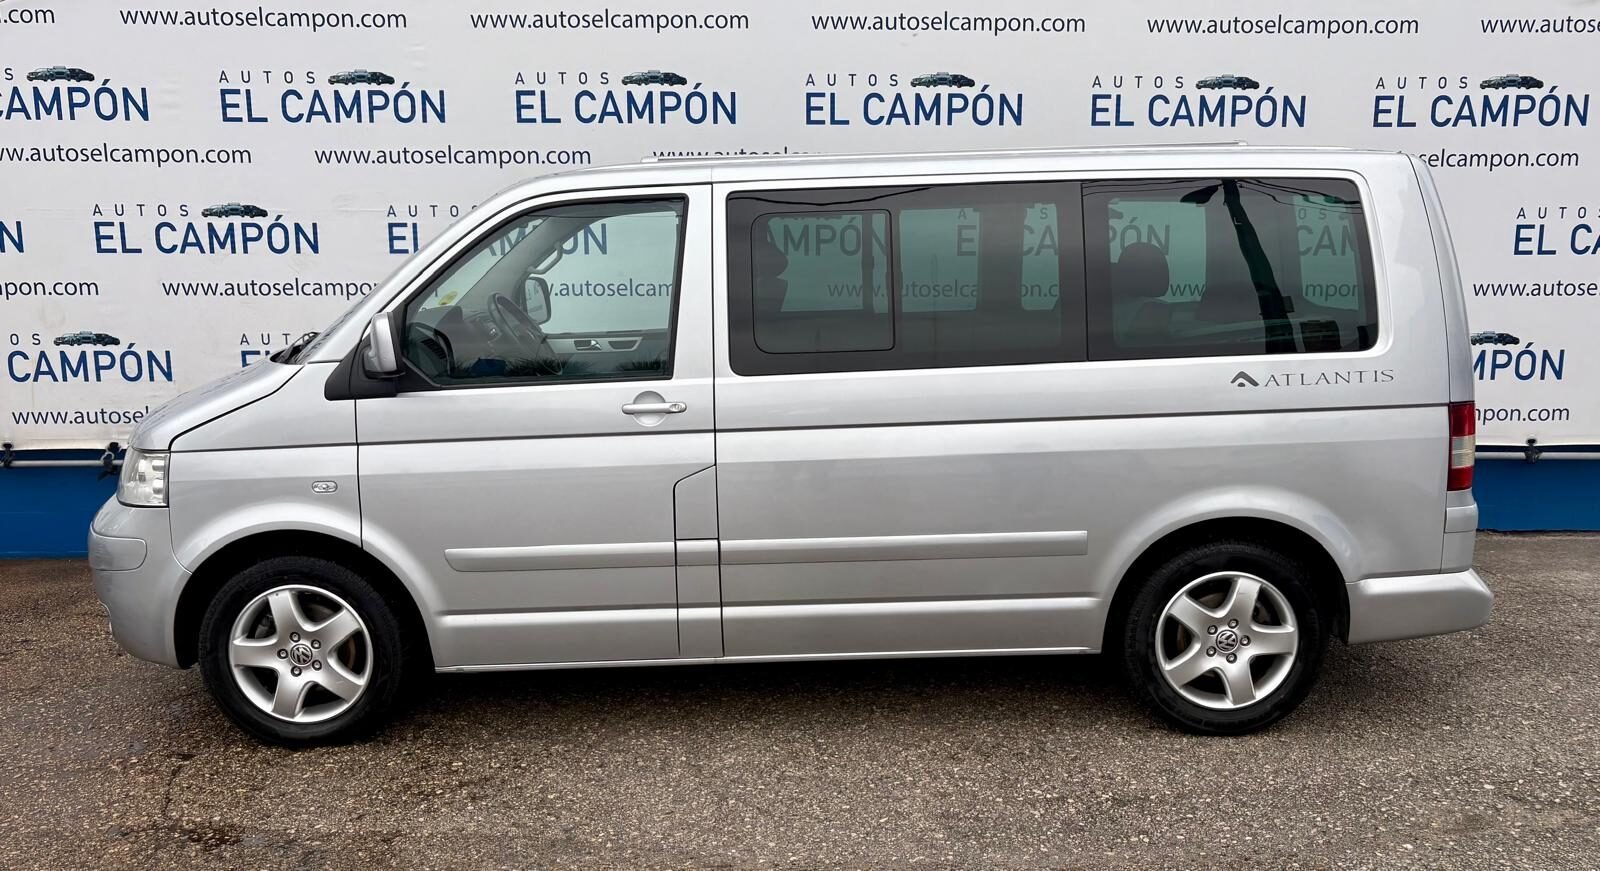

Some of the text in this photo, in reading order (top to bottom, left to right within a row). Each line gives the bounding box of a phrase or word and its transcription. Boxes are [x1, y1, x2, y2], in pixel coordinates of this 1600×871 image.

[119, 6, 407, 33] www.autoselcampon.com
[469, 7, 749, 34] www.autoselcampon.com
[811, 10, 1086, 37] www.autoselcampon.com
[1146, 13, 1419, 40] www.autoselcampon.com
[218, 70, 316, 85] AUTOS
[514, 71, 610, 85] AUTOS
[805, 73, 899, 87] AUTOS
[1091, 75, 1184, 89] AUTOS
[1375, 76, 1468, 90] AUTOS
[0, 78, 150, 122] AMPÓN
[219, 81, 446, 124] EL CAMPÓN
[515, 82, 737, 125] EL CAMPÓN
[805, 84, 1023, 127] EL CAMPÓN
[1090, 86, 1307, 128] EL CAMPÓN
[1372, 85, 1590, 128] EL CAMPÓN
[314, 144, 591, 169] www.autoselcampon.com
[92, 203, 189, 218] AUTOS
[1516, 206, 1600, 220] AUTO
[93, 214, 320, 255] EL CAMPÓN
[1513, 223, 1557, 256] EL
[161, 277, 377, 301] www.autoselcampo
[1472, 279, 1598, 297] www.autose
[7, 342, 174, 383] CAMPÓN
[1264, 369, 1394, 387] ATLANTIS
